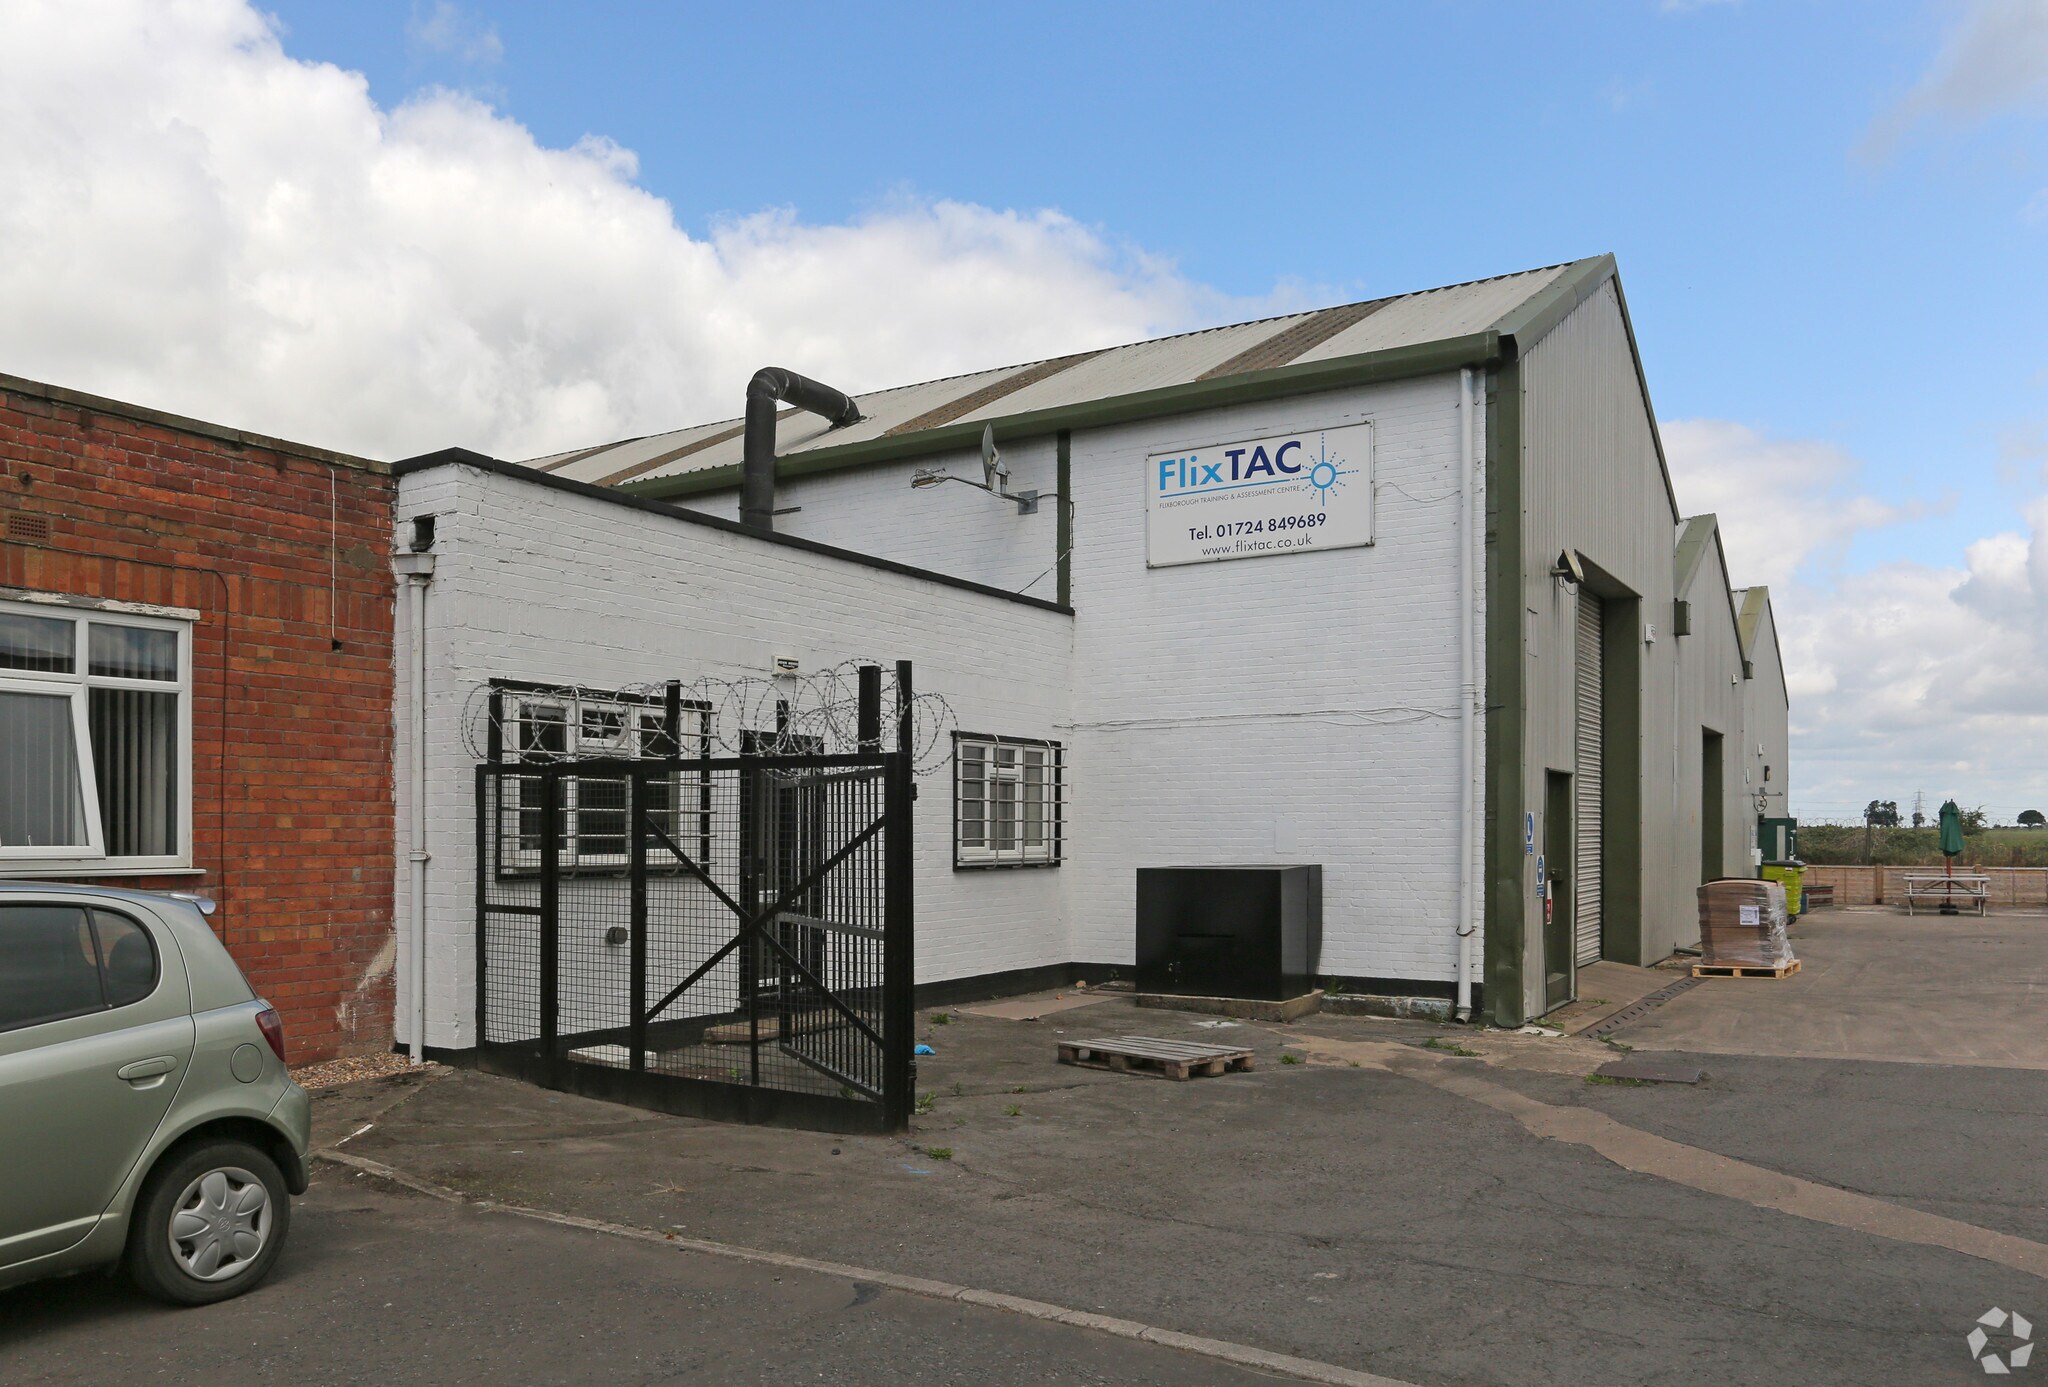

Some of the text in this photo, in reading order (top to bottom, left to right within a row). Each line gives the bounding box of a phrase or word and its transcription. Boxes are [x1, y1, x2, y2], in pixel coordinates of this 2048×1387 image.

[1160, 441, 1301, 490] FlixTAC
[1160, 499, 1199, 509] FLIXBOROUGH
[1201, 494, 1229, 503] TRAINING
[1237, 488, 1275, 498] ASSESSMENT
[1277, 485, 1301, 494] CENTRE
[1189, 513, 1327, 540] Tel. 01724 849689
[1202, 533, 1313, 555] www.flixtac.co.uk
